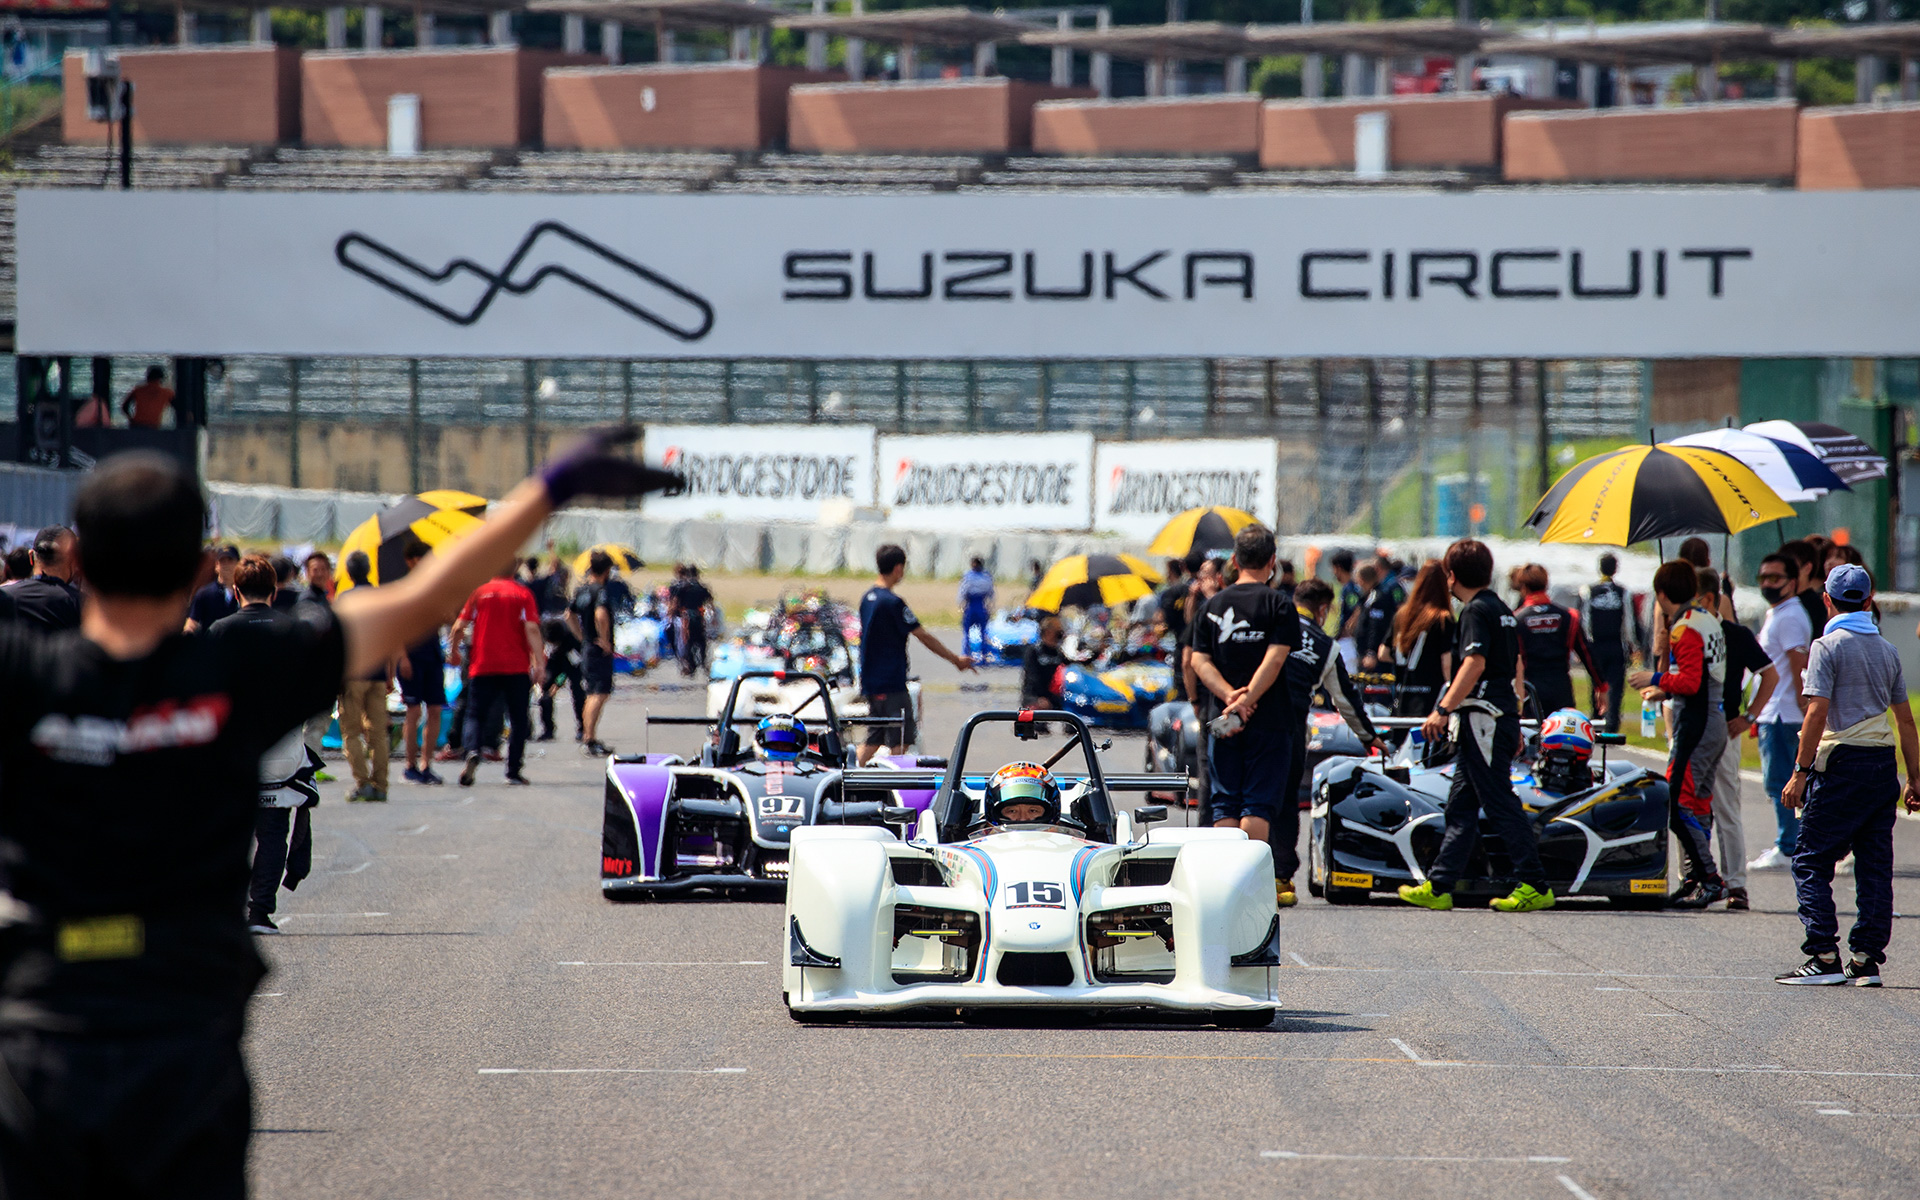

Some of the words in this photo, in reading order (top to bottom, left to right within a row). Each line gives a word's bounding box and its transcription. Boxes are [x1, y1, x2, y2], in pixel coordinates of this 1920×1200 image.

[782, 250, 1255, 301] SUZUKA
[1300, 248, 1753, 300] CIRCUIT
[895, 457, 1077, 506] BRIDGESTONE
[1588, 457, 1628, 523] DUNLOP
[1687, 452, 1753, 507] DUNLOP
[761, 798, 801, 814] 97
[1006, 882, 1063, 904] 15
[1336, 875, 1369, 884] DUNLOP
